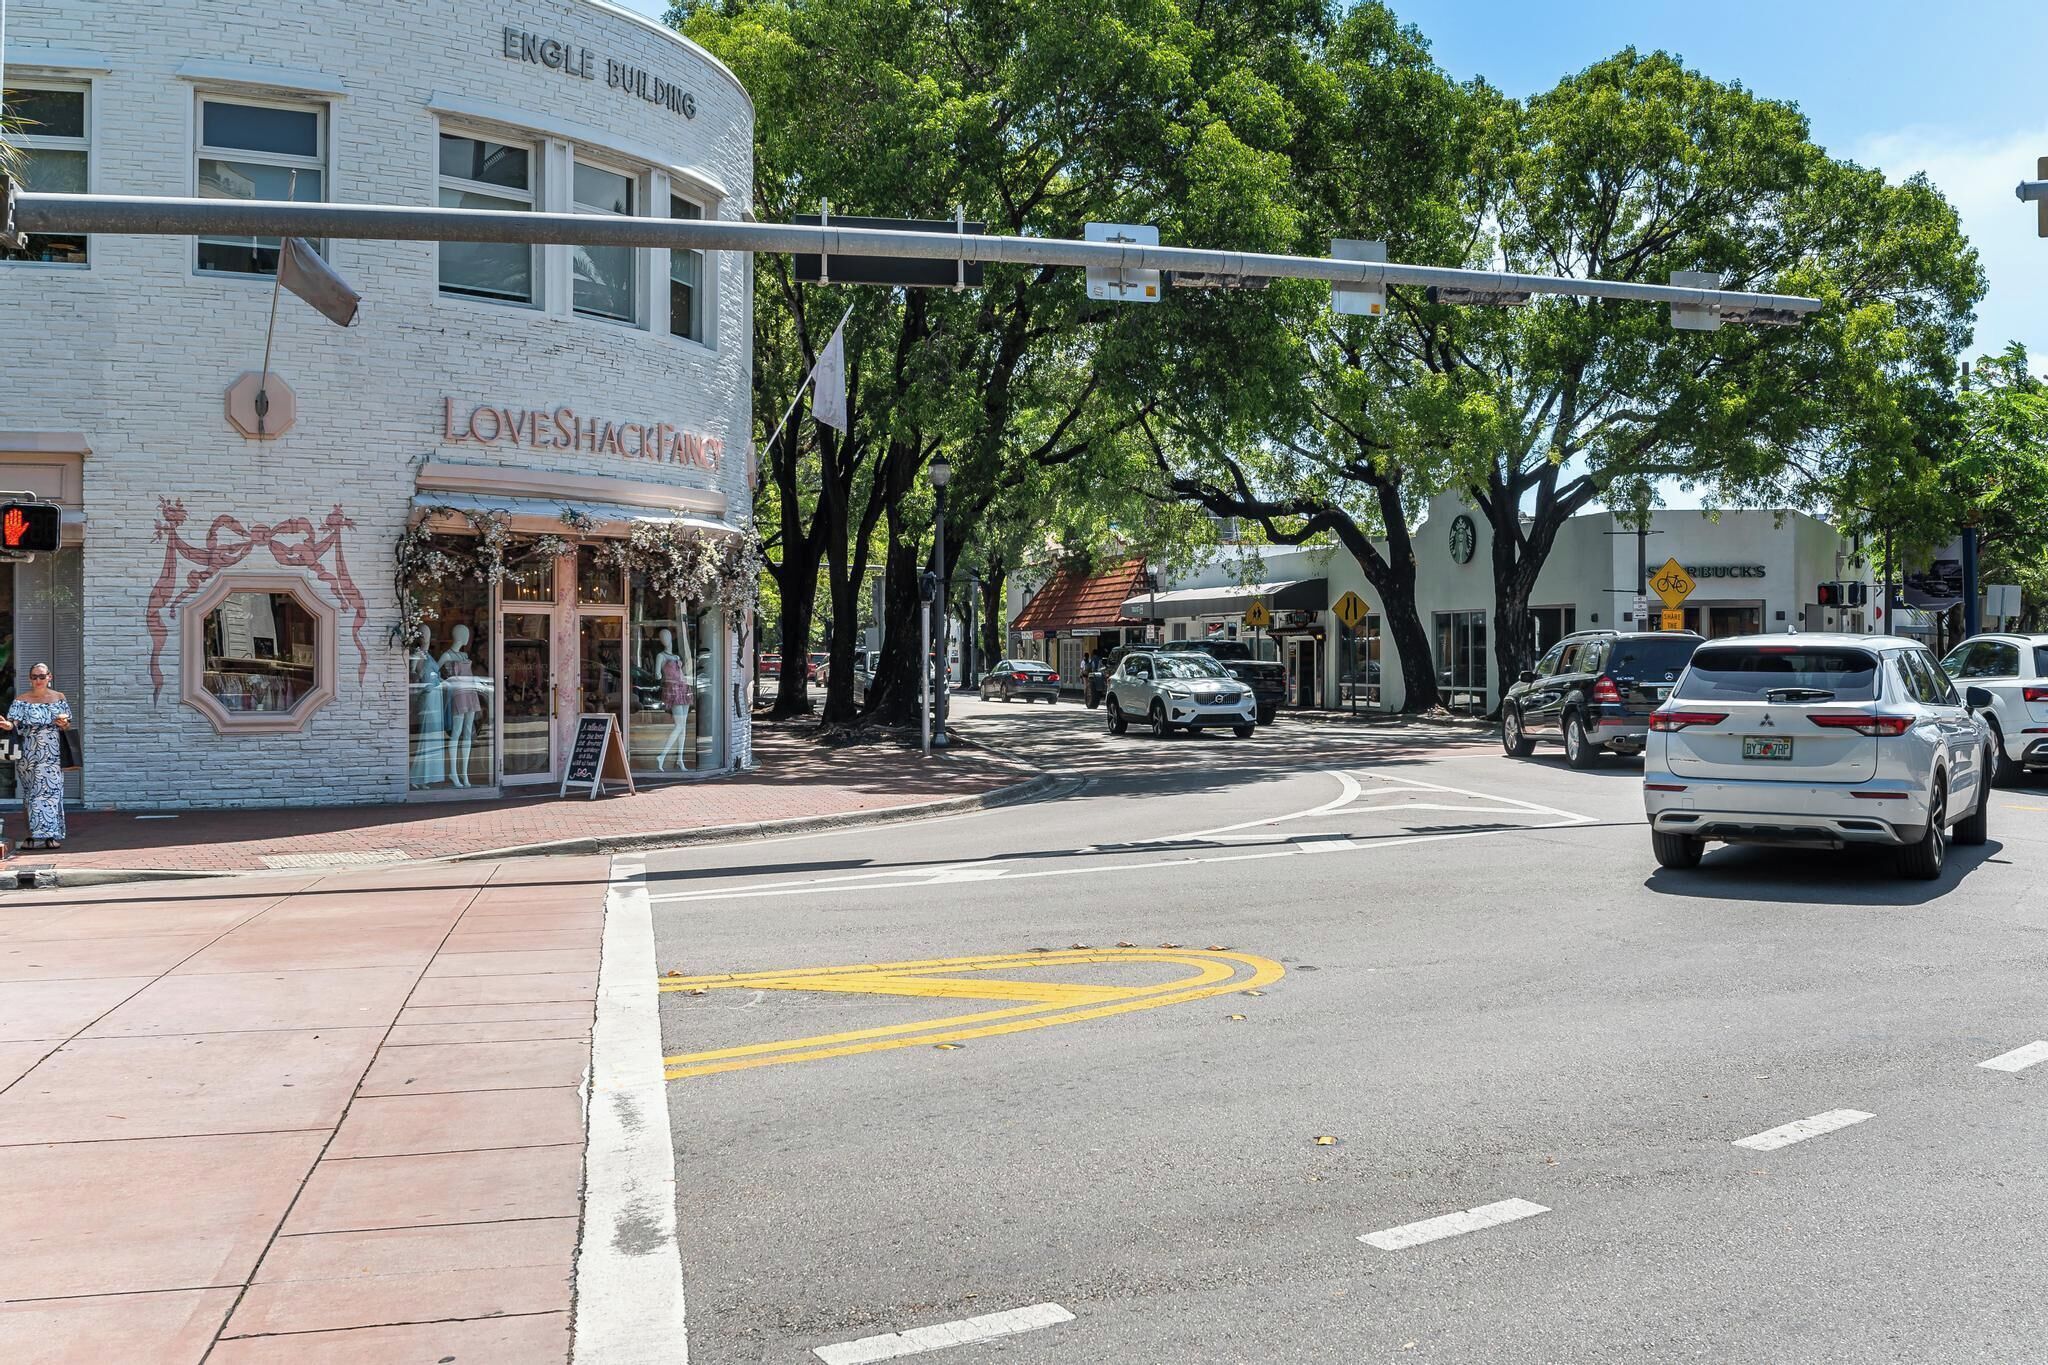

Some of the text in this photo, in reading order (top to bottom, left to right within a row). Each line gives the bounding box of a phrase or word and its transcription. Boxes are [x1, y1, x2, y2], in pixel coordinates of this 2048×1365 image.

[504, 26, 697, 120] ENGLE BUILDING
[1647, 565, 1766, 578] SRBUCKS
